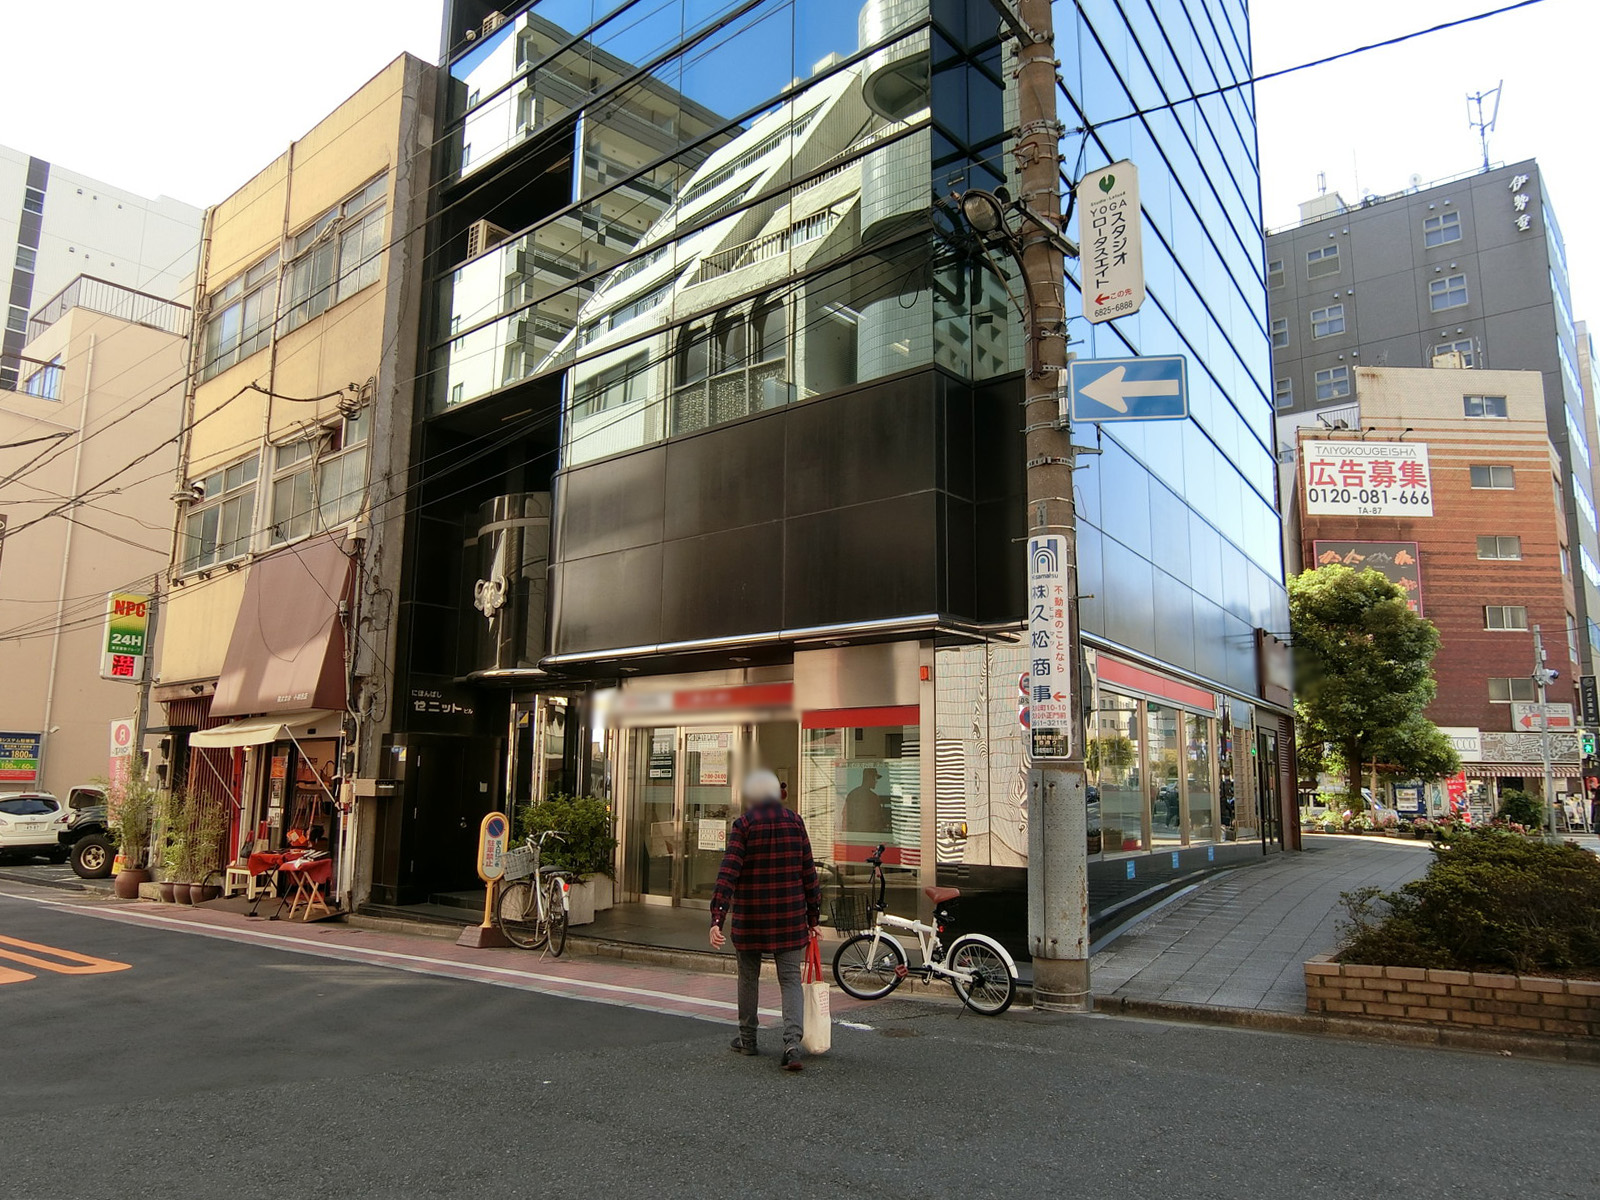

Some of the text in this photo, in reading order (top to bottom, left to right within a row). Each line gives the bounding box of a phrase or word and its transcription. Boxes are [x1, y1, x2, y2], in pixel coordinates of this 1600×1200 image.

[1090, 199, 1127, 217] YOGA
[1111, 211, 1128, 267] スタジオ
[1092, 216, 1109, 289] ロータスエイト
[1110, 289, 1132, 300] この先
[1094, 300, 1133, 317] 6825-6888
[1315, 446, 1416, 456] TAIYOKOUGEISHA
[1309, 459, 1427, 488] 広告募集
[1309, 489, 1429, 504] 0120-081-666
[114, 600, 146, 617] NPC
[1054, 585, 1065, 673] 不動産のことなら
[111, 634, 142, 646] 24H
[112, 655, 135, 677] 満
[411, 689, 442, 699] にほんばし
